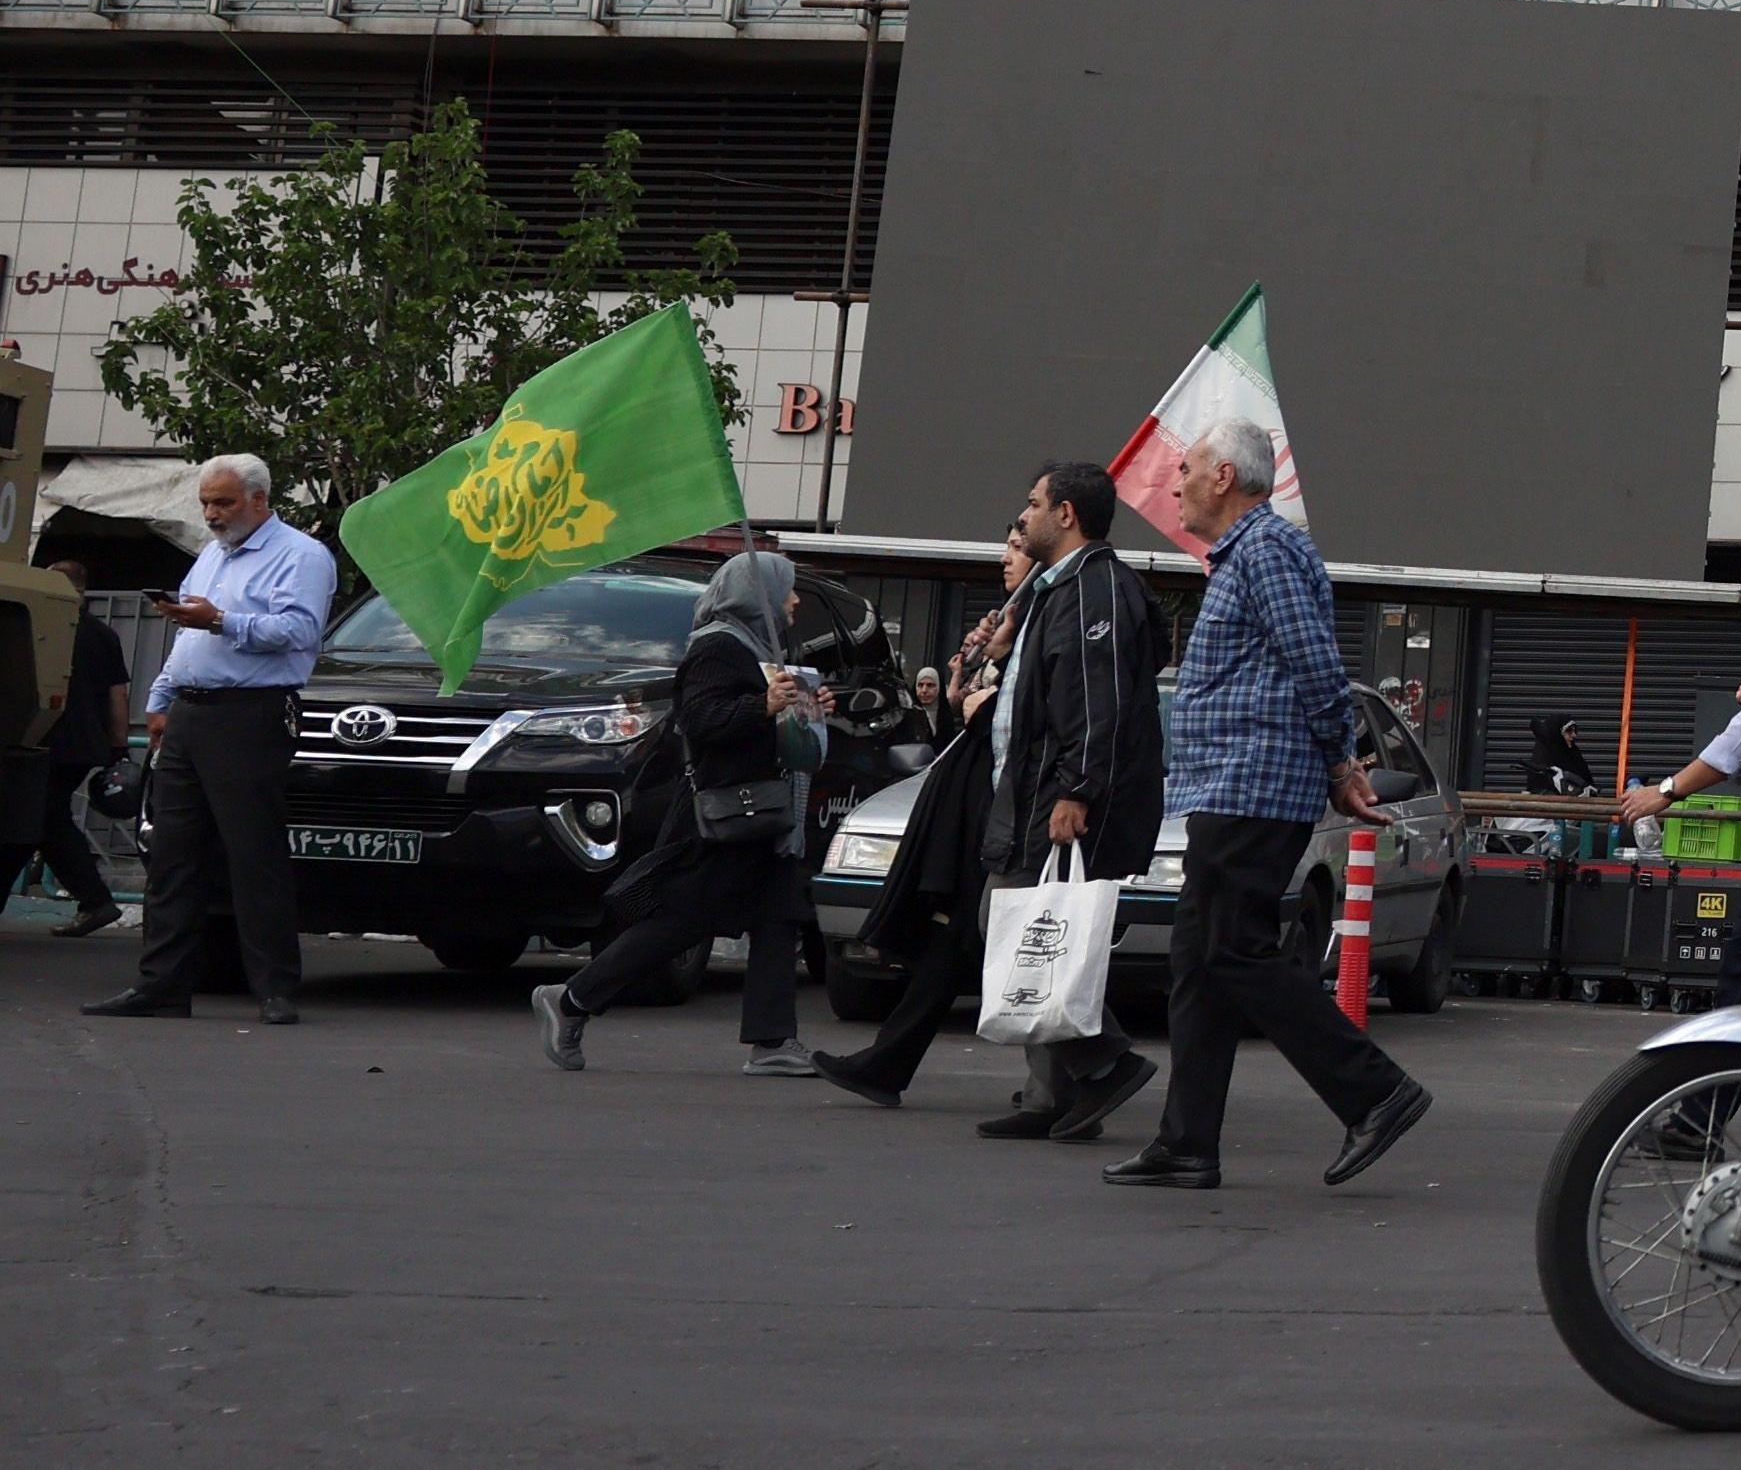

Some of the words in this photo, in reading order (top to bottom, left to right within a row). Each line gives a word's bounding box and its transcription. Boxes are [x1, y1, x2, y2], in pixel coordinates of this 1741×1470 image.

[15, 262, 95, 296] هنری
[1701, 896, 1723, 910] 4K
[1700, 926, 1718, 938] 216
